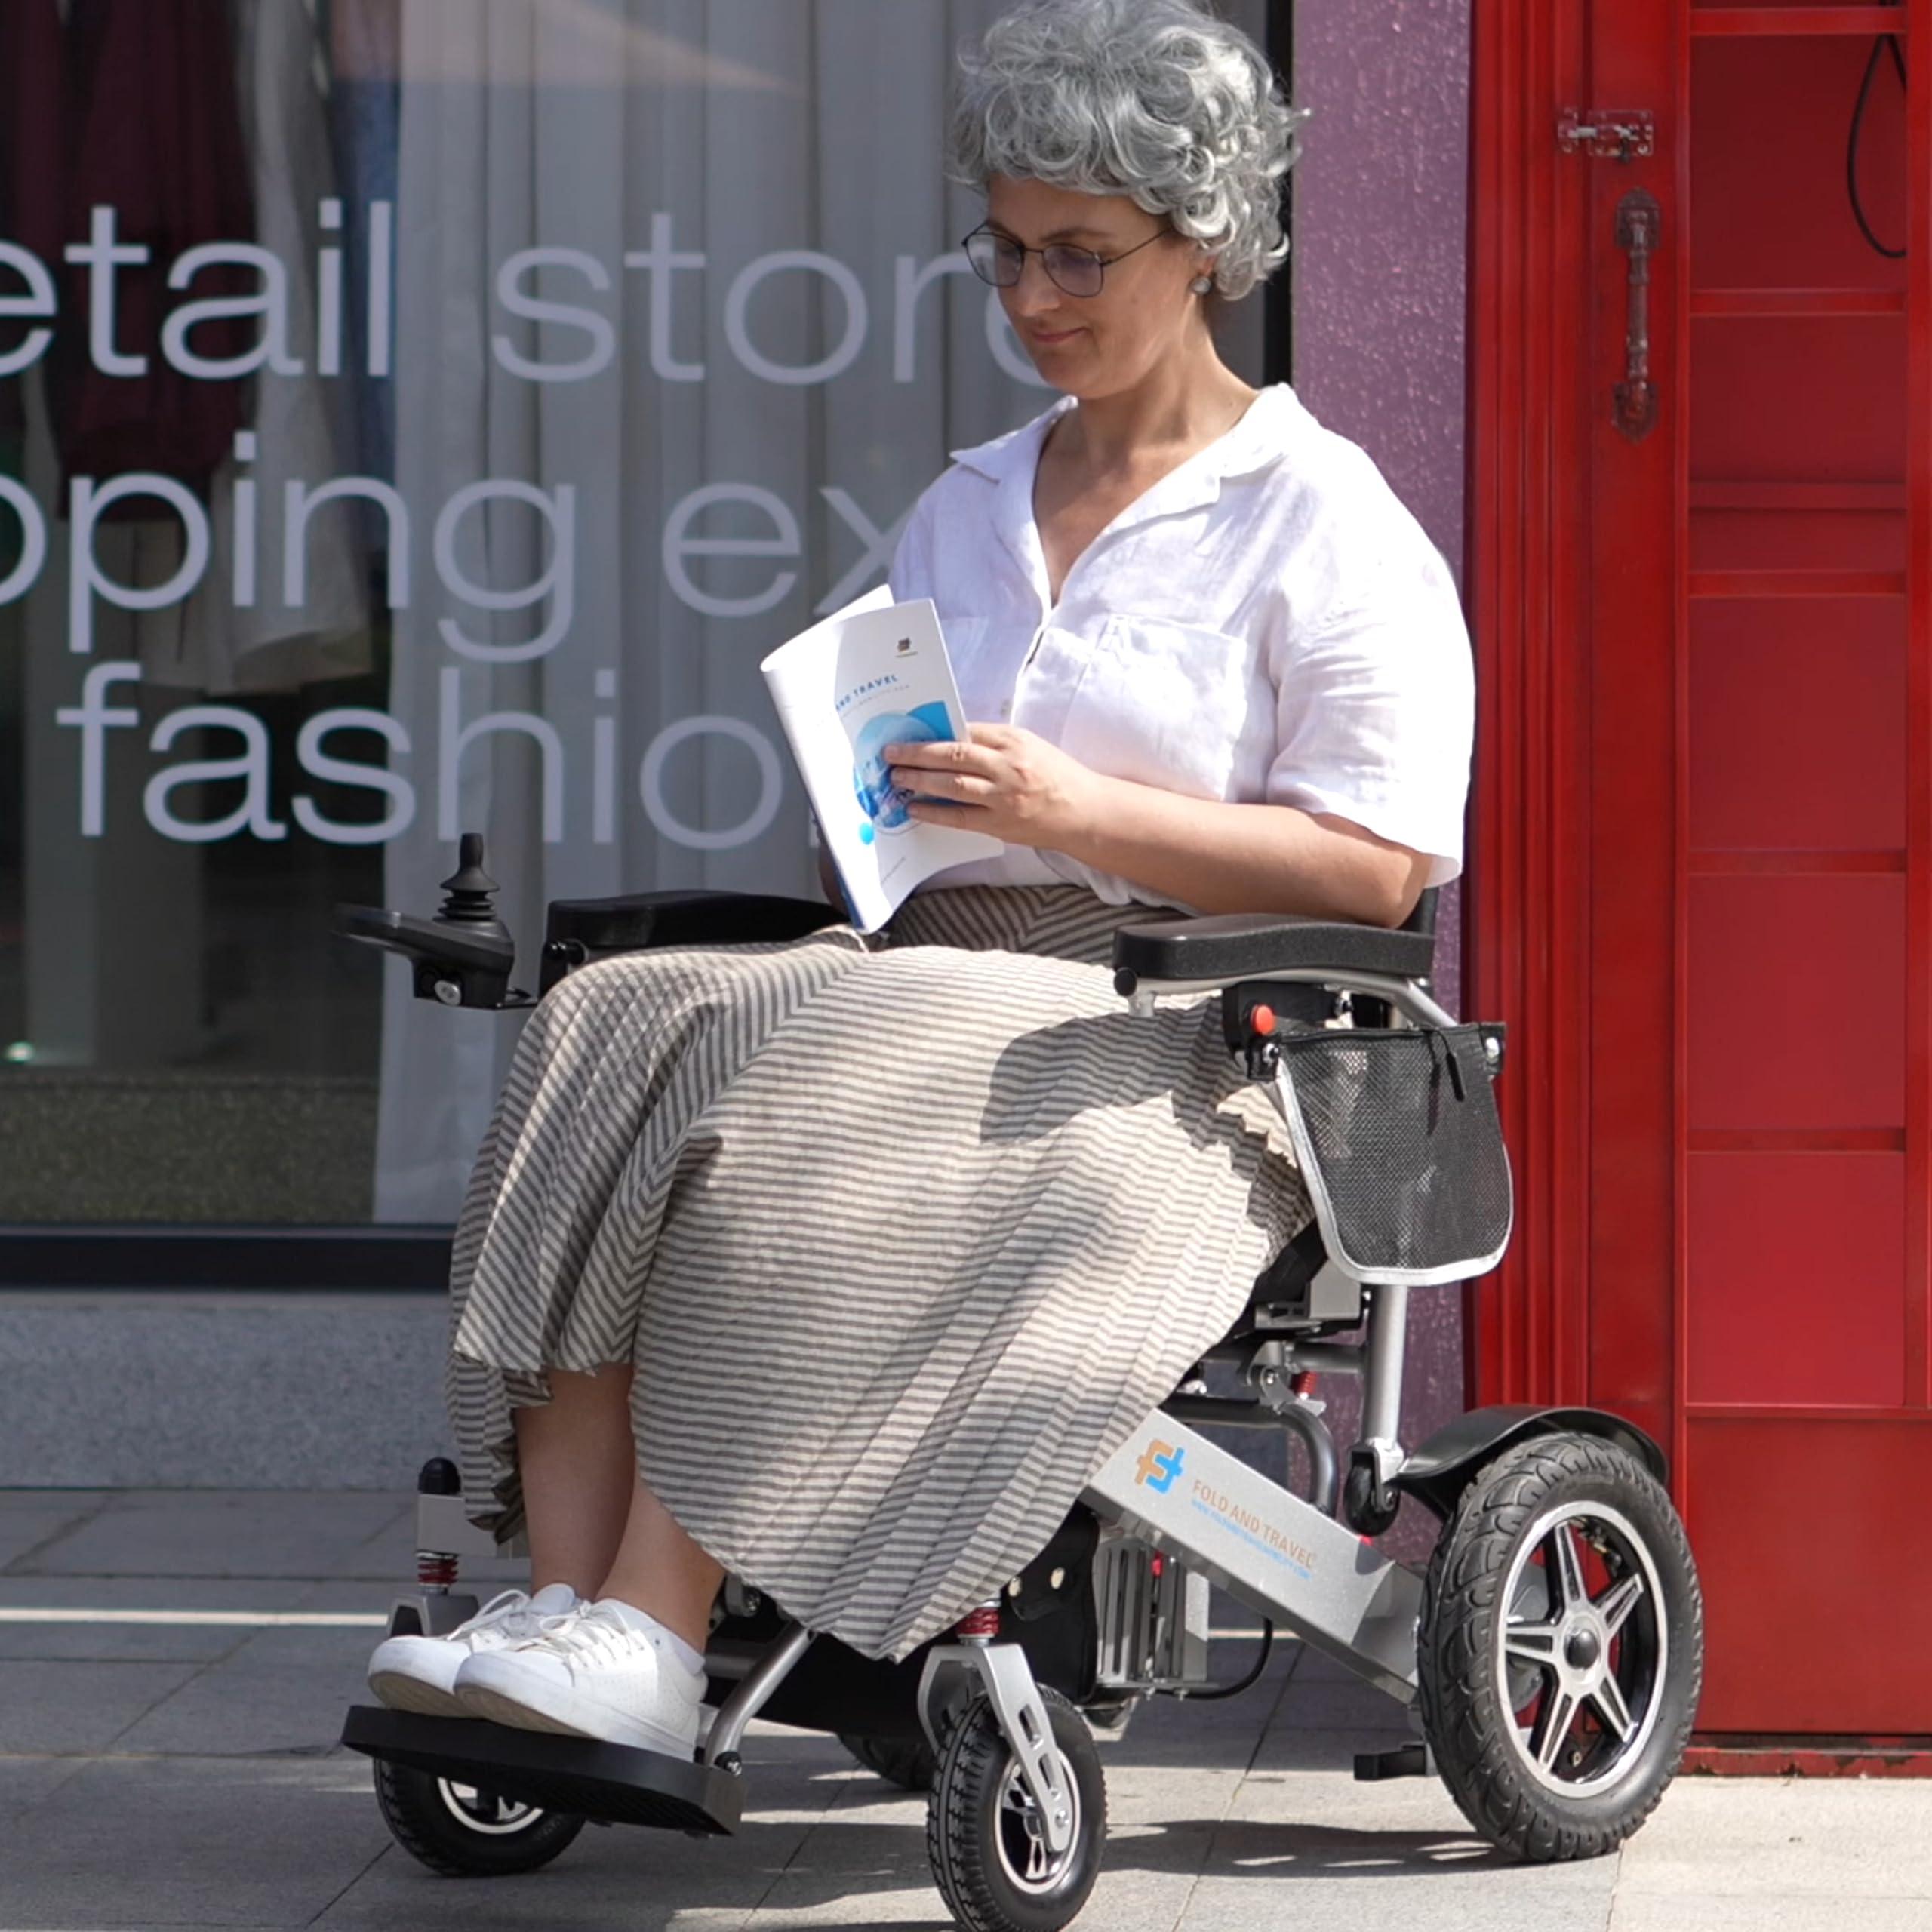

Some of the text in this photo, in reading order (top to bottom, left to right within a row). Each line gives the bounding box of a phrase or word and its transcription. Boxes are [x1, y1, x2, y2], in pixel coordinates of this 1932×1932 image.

[854, 674, 897, 697] TRAVEL
[56, 660, 820, 851] fashio
[1192, 1479, 1315, 1570] FOLD AND TRAVEL
